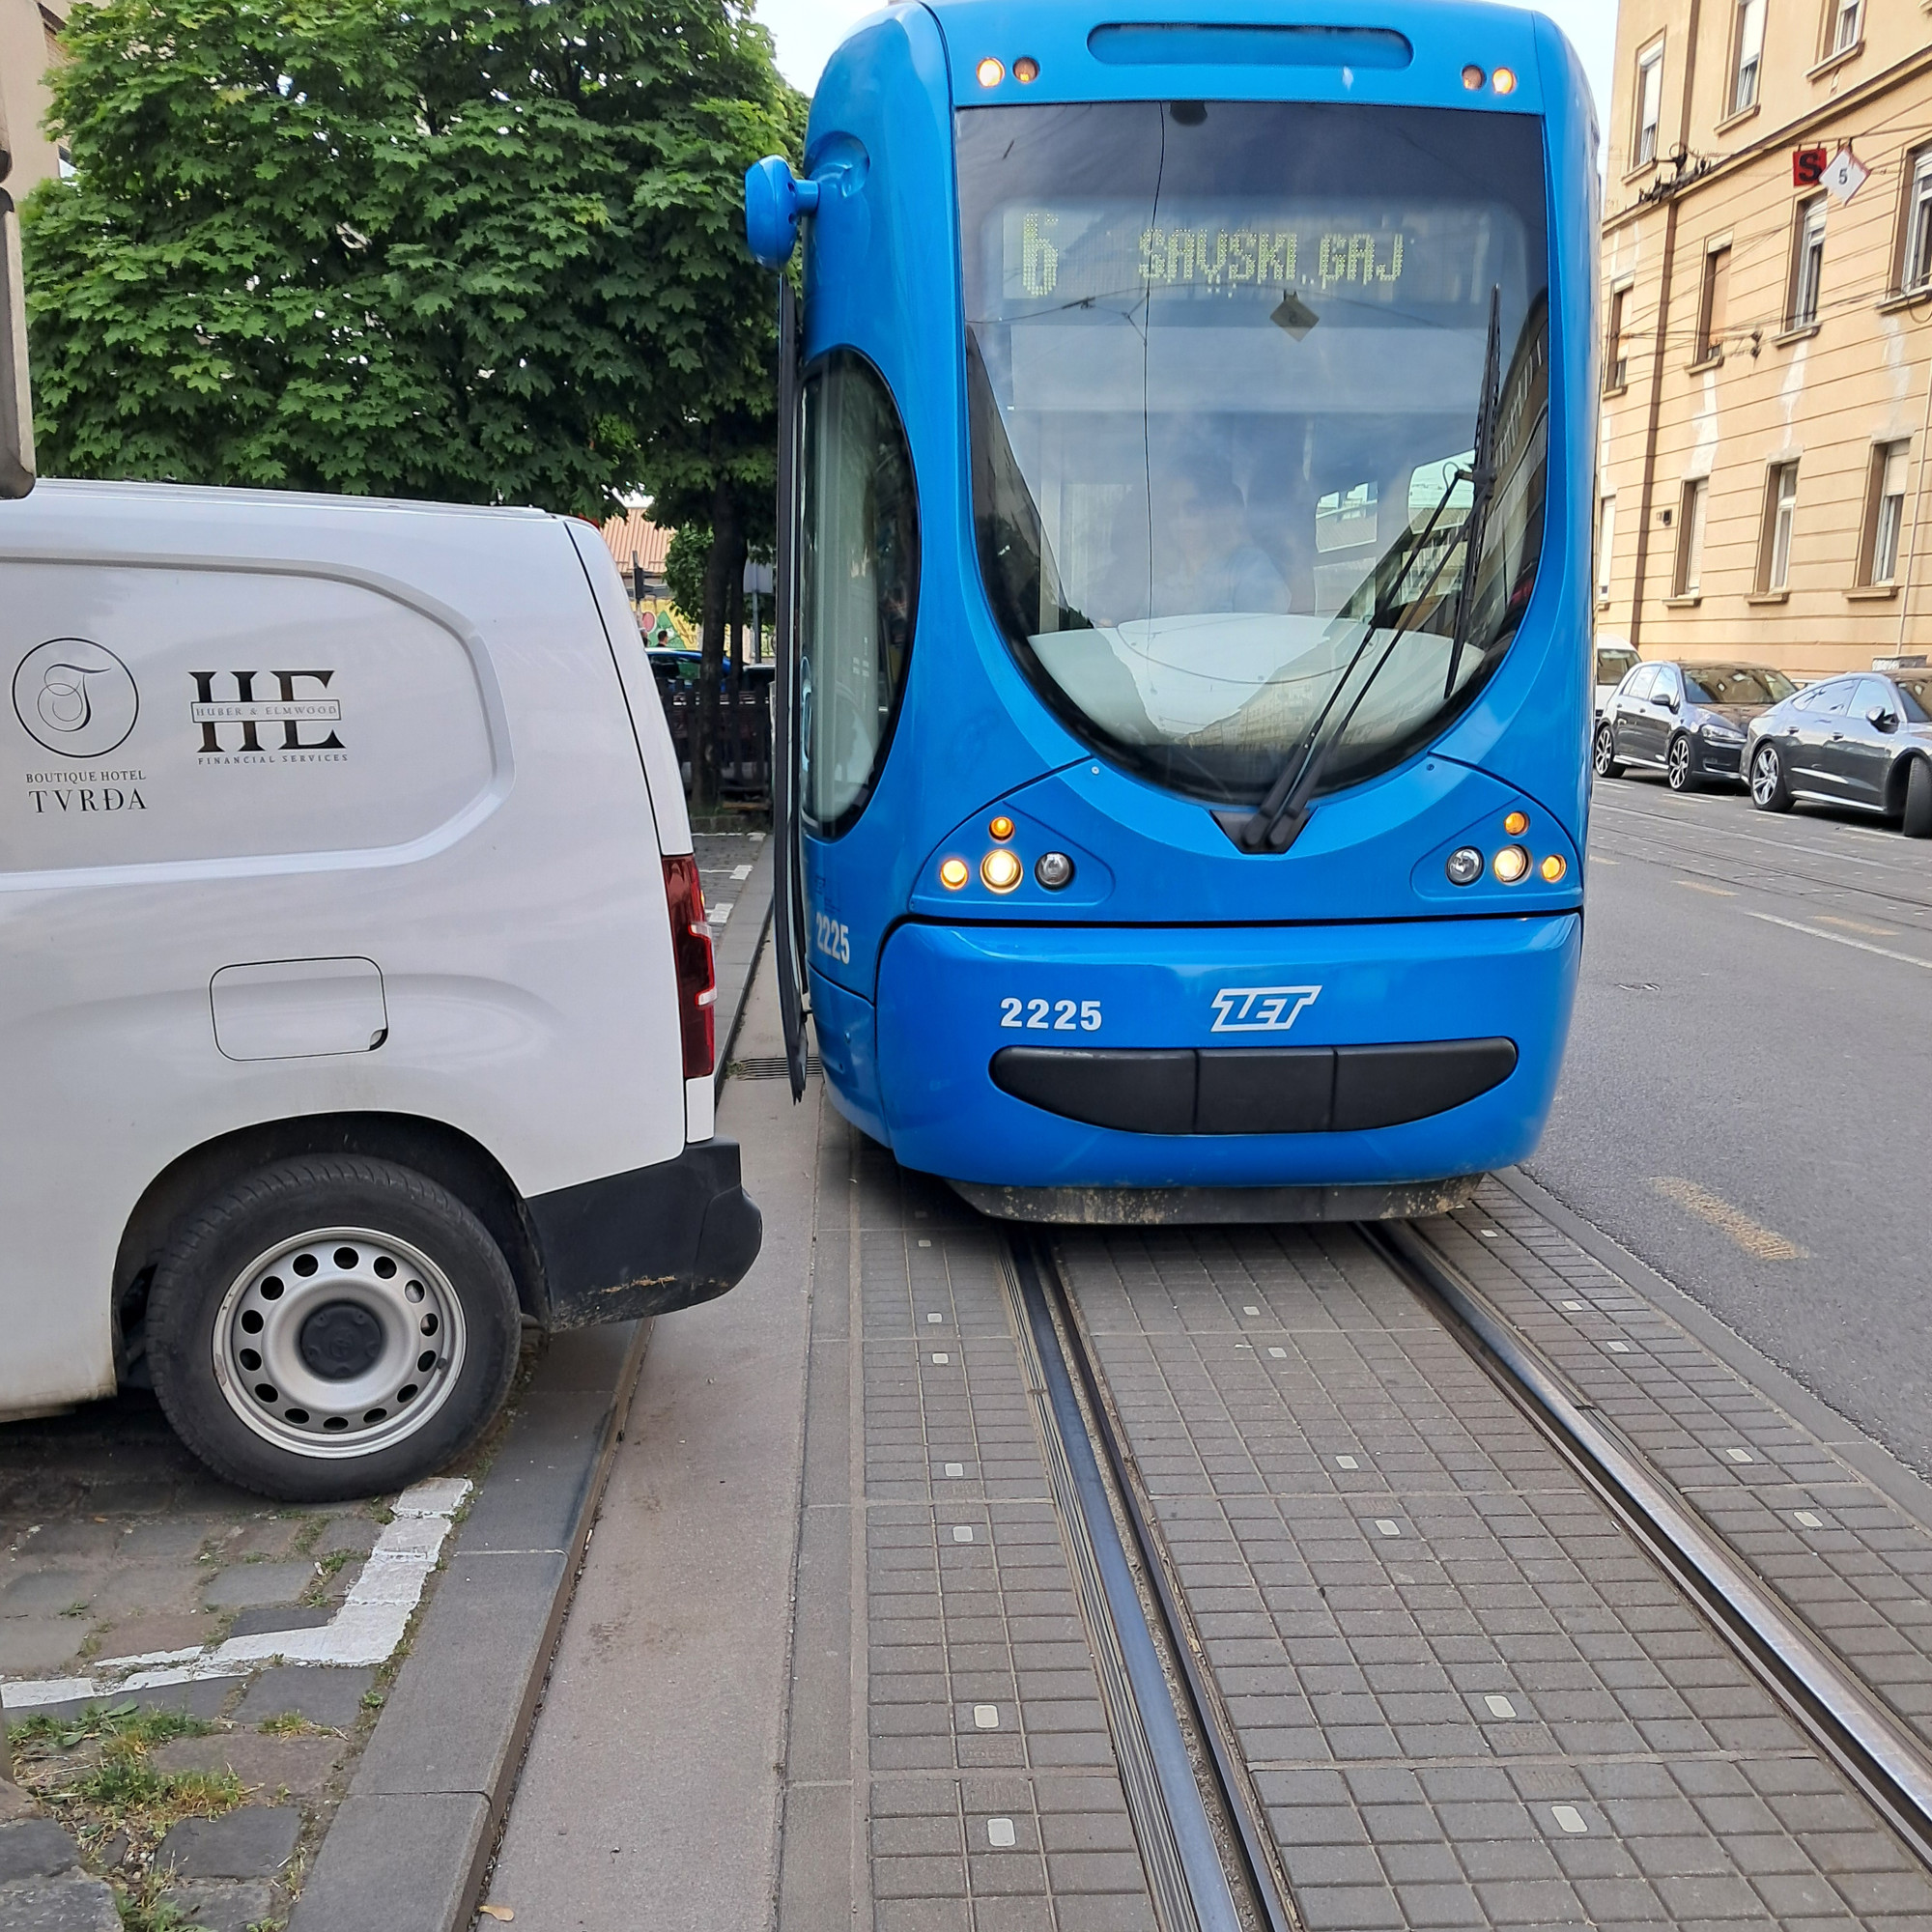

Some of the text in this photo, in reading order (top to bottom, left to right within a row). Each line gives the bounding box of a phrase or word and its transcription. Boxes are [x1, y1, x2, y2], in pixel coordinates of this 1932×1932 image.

[1799, 153, 1823, 182] S
[1838, 168, 1848, 185] 5
[1022, 213, 1059, 296] 6
[1318, 233, 1404, 286] GAJ
[196, 704, 337, 717] HUBER & ELMWOOD
[198, 753, 349, 765] FINANCIAL SERVICES
[26, 770, 147, 784] BOUTIQUE HOTEL
[28, 787, 148, 813] TVRĐA
[815, 911, 850, 965] 2225
[1001, 997, 1101, 1031] 2225
[1210, 984, 1322, 1033] ZET
